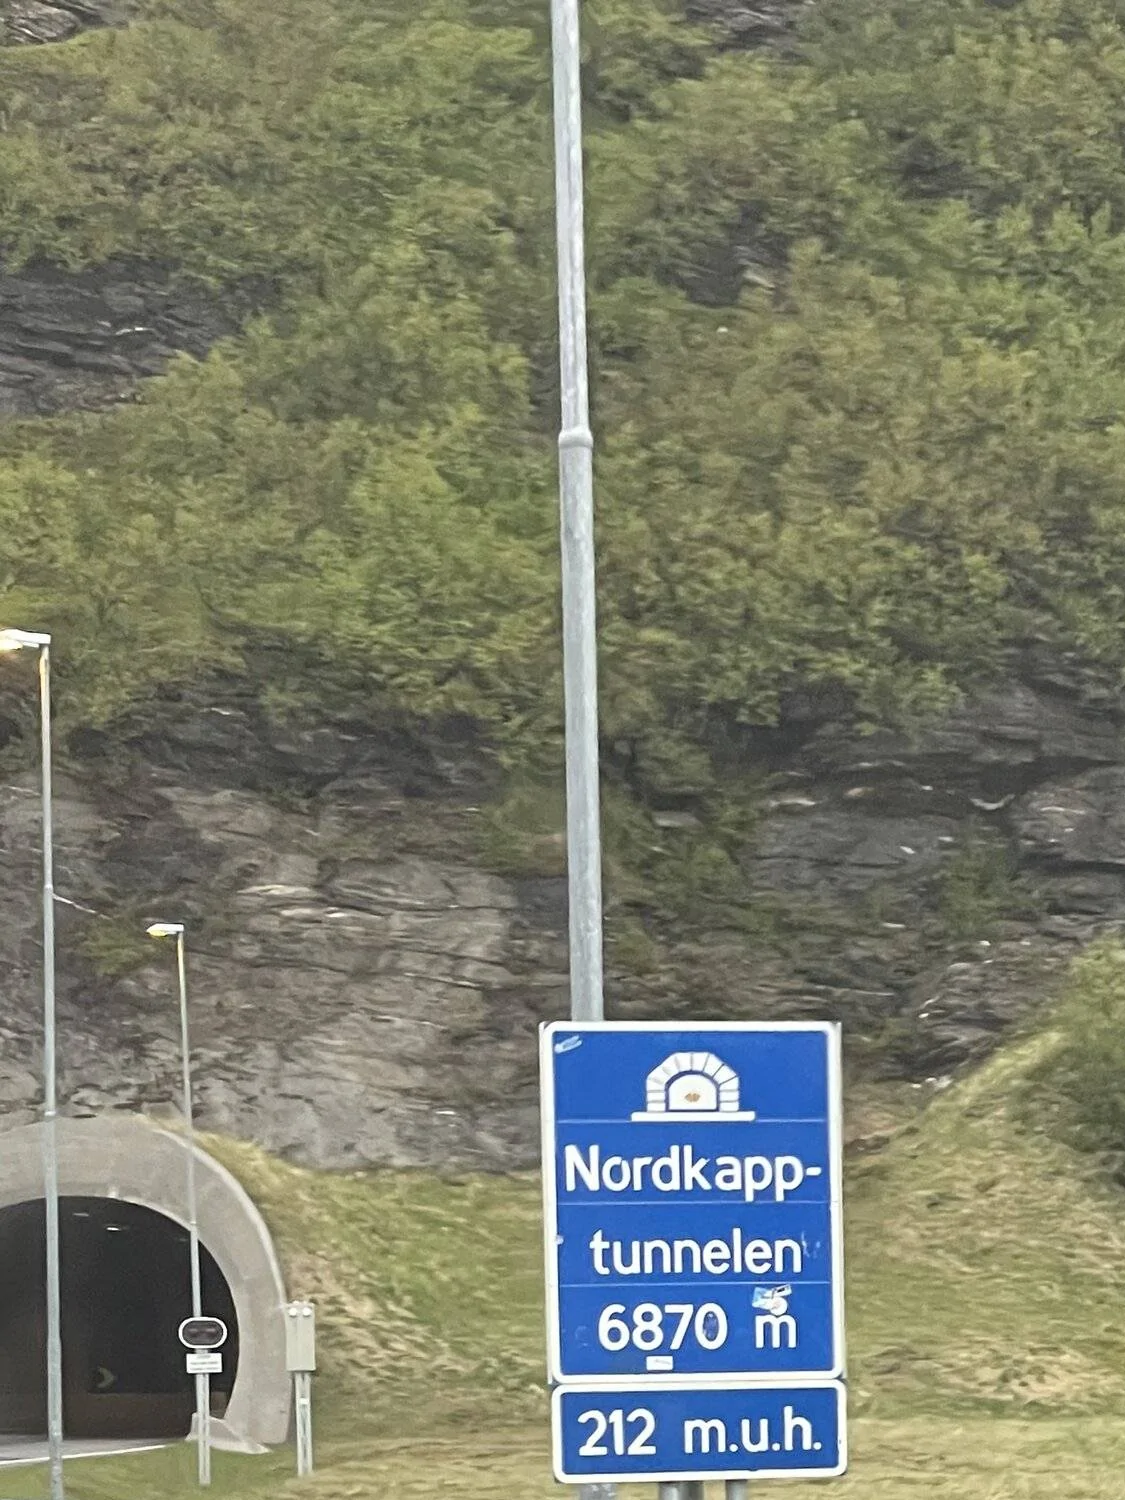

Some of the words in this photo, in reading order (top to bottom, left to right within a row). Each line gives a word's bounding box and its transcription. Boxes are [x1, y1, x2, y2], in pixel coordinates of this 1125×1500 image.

[564, 1144, 823, 1202] Nordkapp-
[588, 1227, 802, 1275] tunnelen
[598, 1302, 728, 1351] 6870
[754, 1313, 798, 1349] m
[577, 1408, 657, 1456] 212
[684, 1405, 823, 1455] m.u.h.
